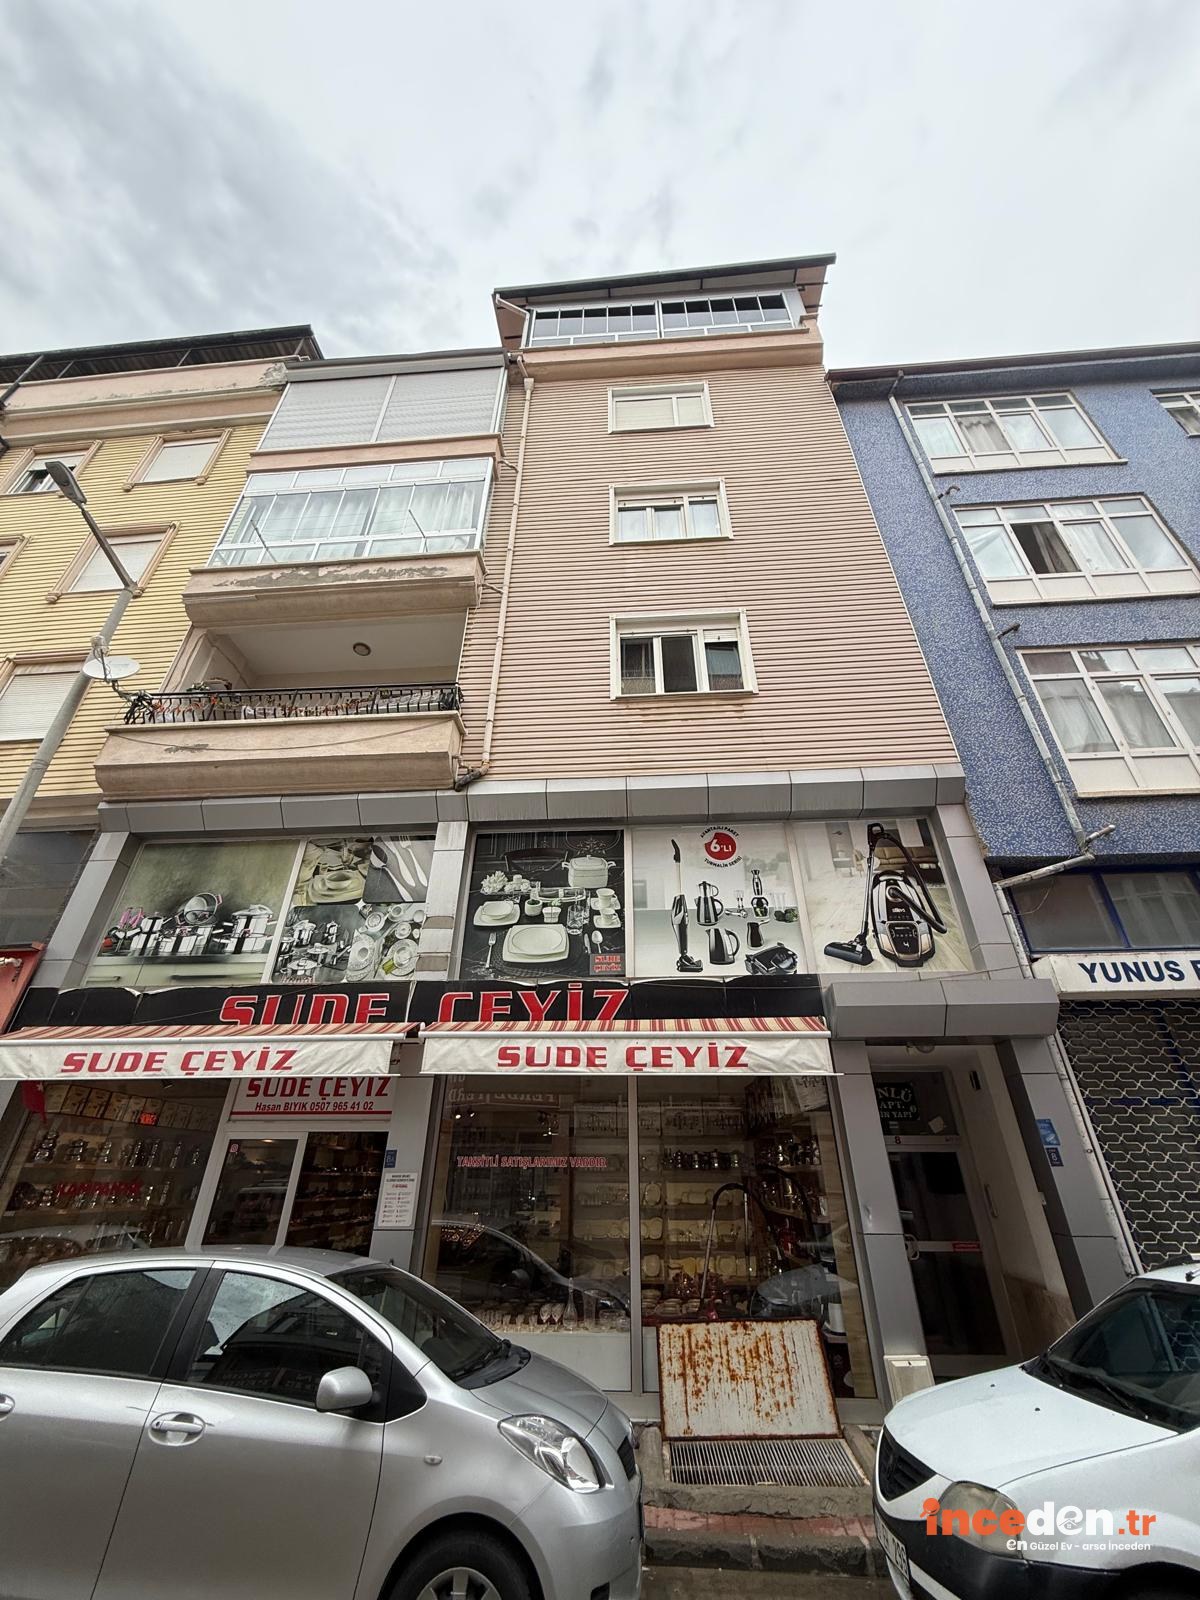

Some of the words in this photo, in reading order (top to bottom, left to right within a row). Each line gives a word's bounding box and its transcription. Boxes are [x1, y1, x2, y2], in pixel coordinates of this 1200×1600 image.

[1078, 960, 1185, 983] YUNUS
[219, 993, 390, 1027] SUDE
[61, 1051, 168, 1073] SUDE
[180, 1046, 298, 1076] ÇEYİZ
[496, 1046, 608, 1068] SUDE
[625, 1042, 749, 1072] ÇEYİZ
[246, 1077, 313, 1097] SUDE
[876, 1087, 912, 1102] NLÜ
[255, 1102, 282, 1112] Hasan
[283, 1102, 307, 1111] BIYIK
[309, 1102, 331, 1111] 0507
[332, 1102, 348, 1111] 965
[350, 1102, 361, 1111] 41
[363, 1101, 374, 1110] 02
[570, 1156, 608, 1168] VARDIR
